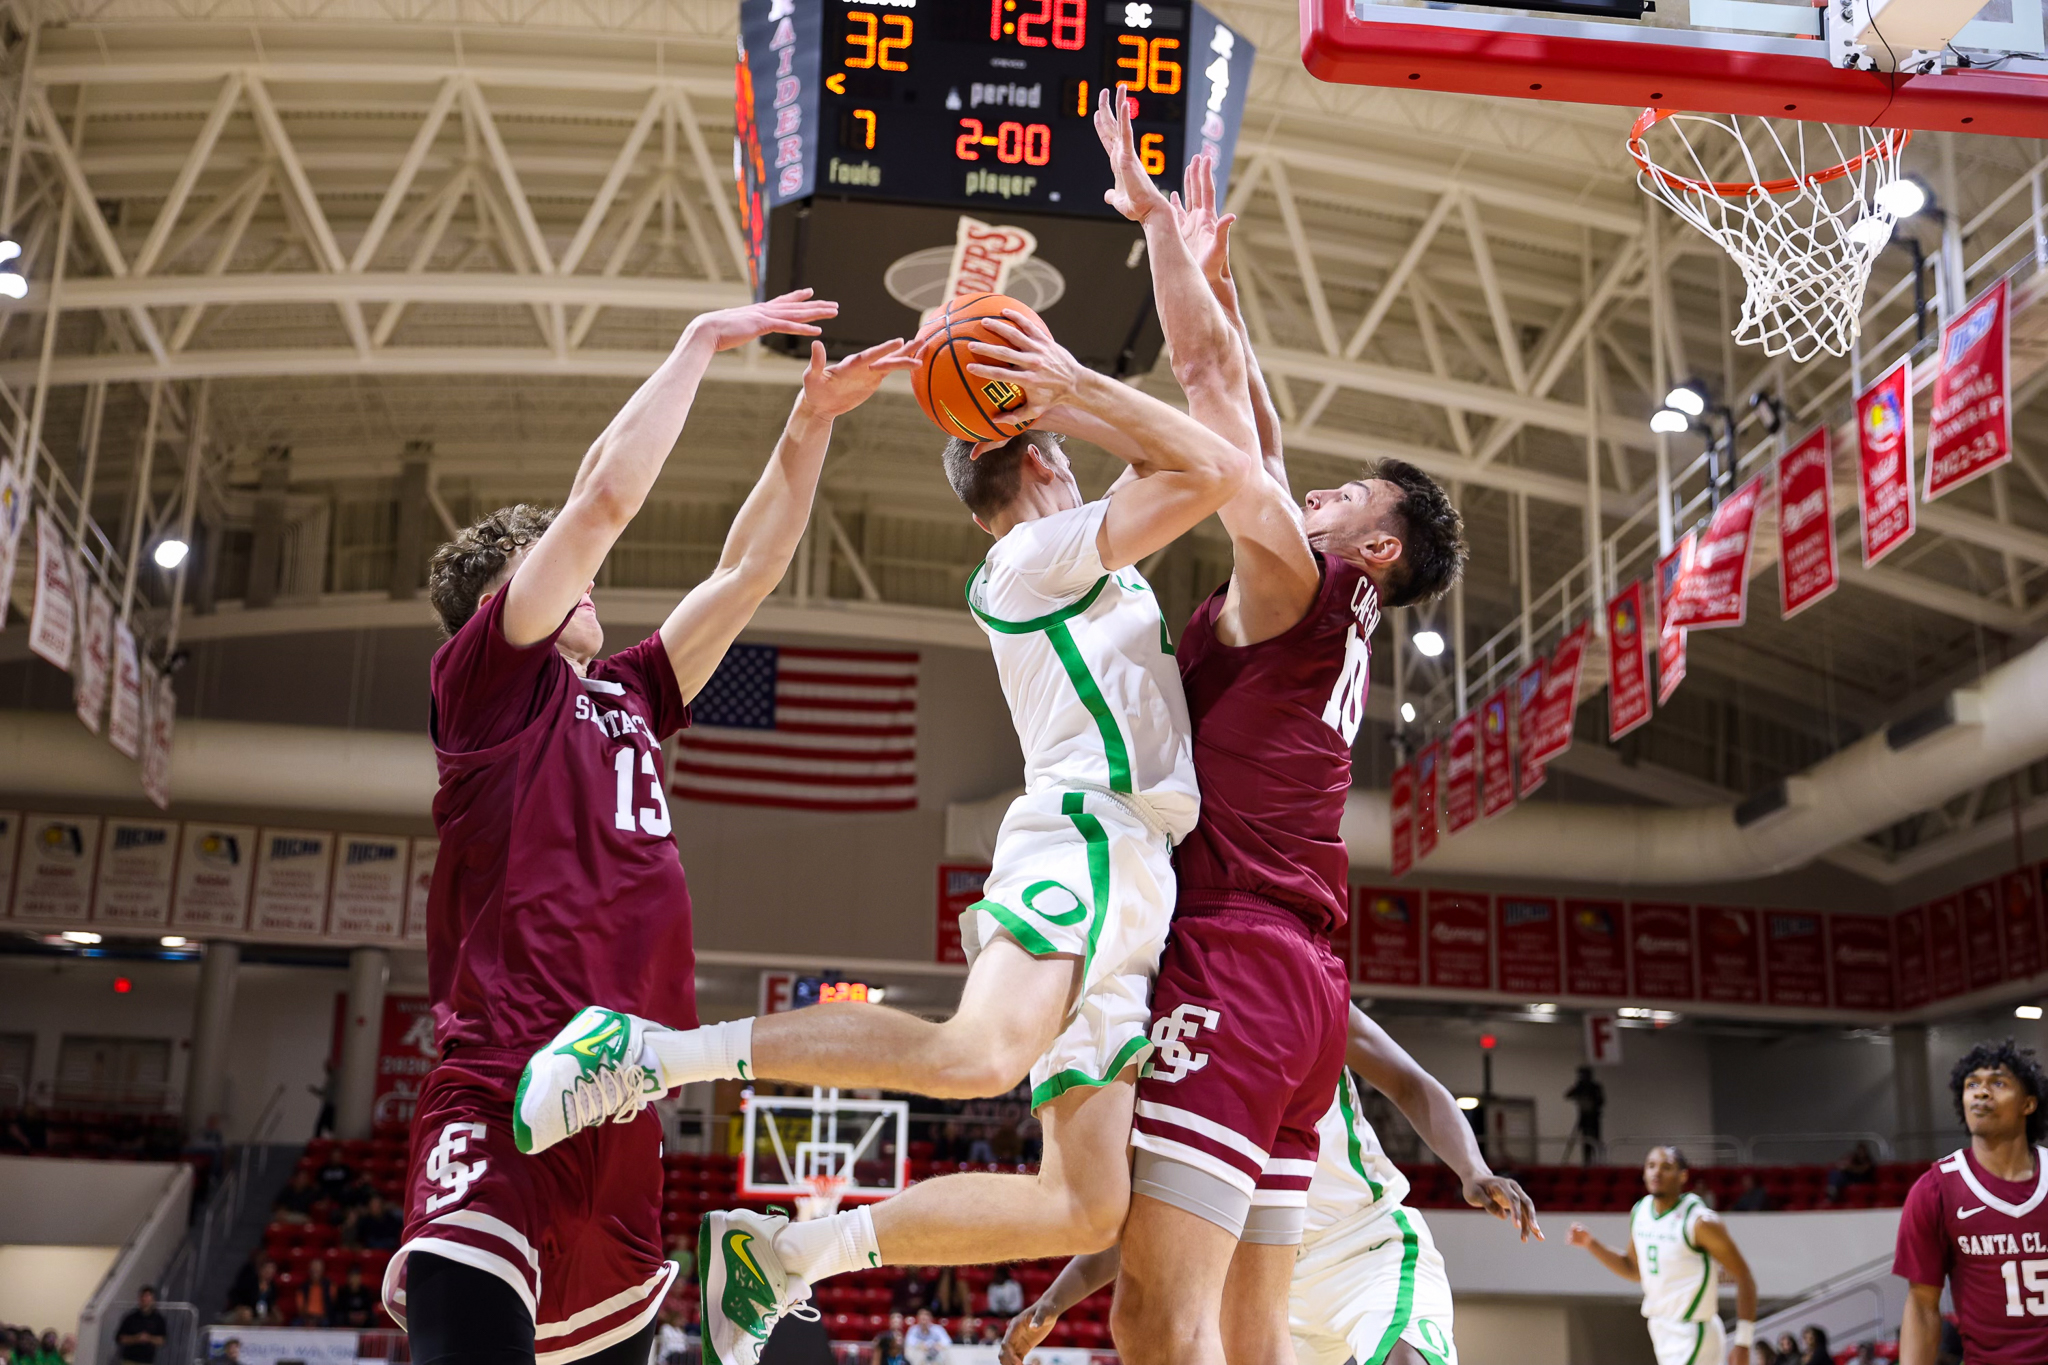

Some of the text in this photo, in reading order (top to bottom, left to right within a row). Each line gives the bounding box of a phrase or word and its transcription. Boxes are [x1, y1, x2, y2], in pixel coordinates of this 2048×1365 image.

[844, 11, 914, 72] 32
[990, 0, 1087, 50] 1:28
[1116, 34, 1181, 95] 36
[970, 83, 1042, 109] period
[853, 109, 877, 150] 7
[956, 118, 1050, 166] 2-00
[829, 157, 881, 187] fouls
[1140, 133, 1165, 175] 6
[966, 168, 1037, 199] player
[955, 226, 1025, 297] DERS
[1321, 622, 1369, 748] 10
[614, 747, 672, 837] 13
[1647, 1244, 1660, 1274] 9
[1957, 1231, 2048, 1256] SANTA CL
[2001, 1259, 2048, 1317] 15
